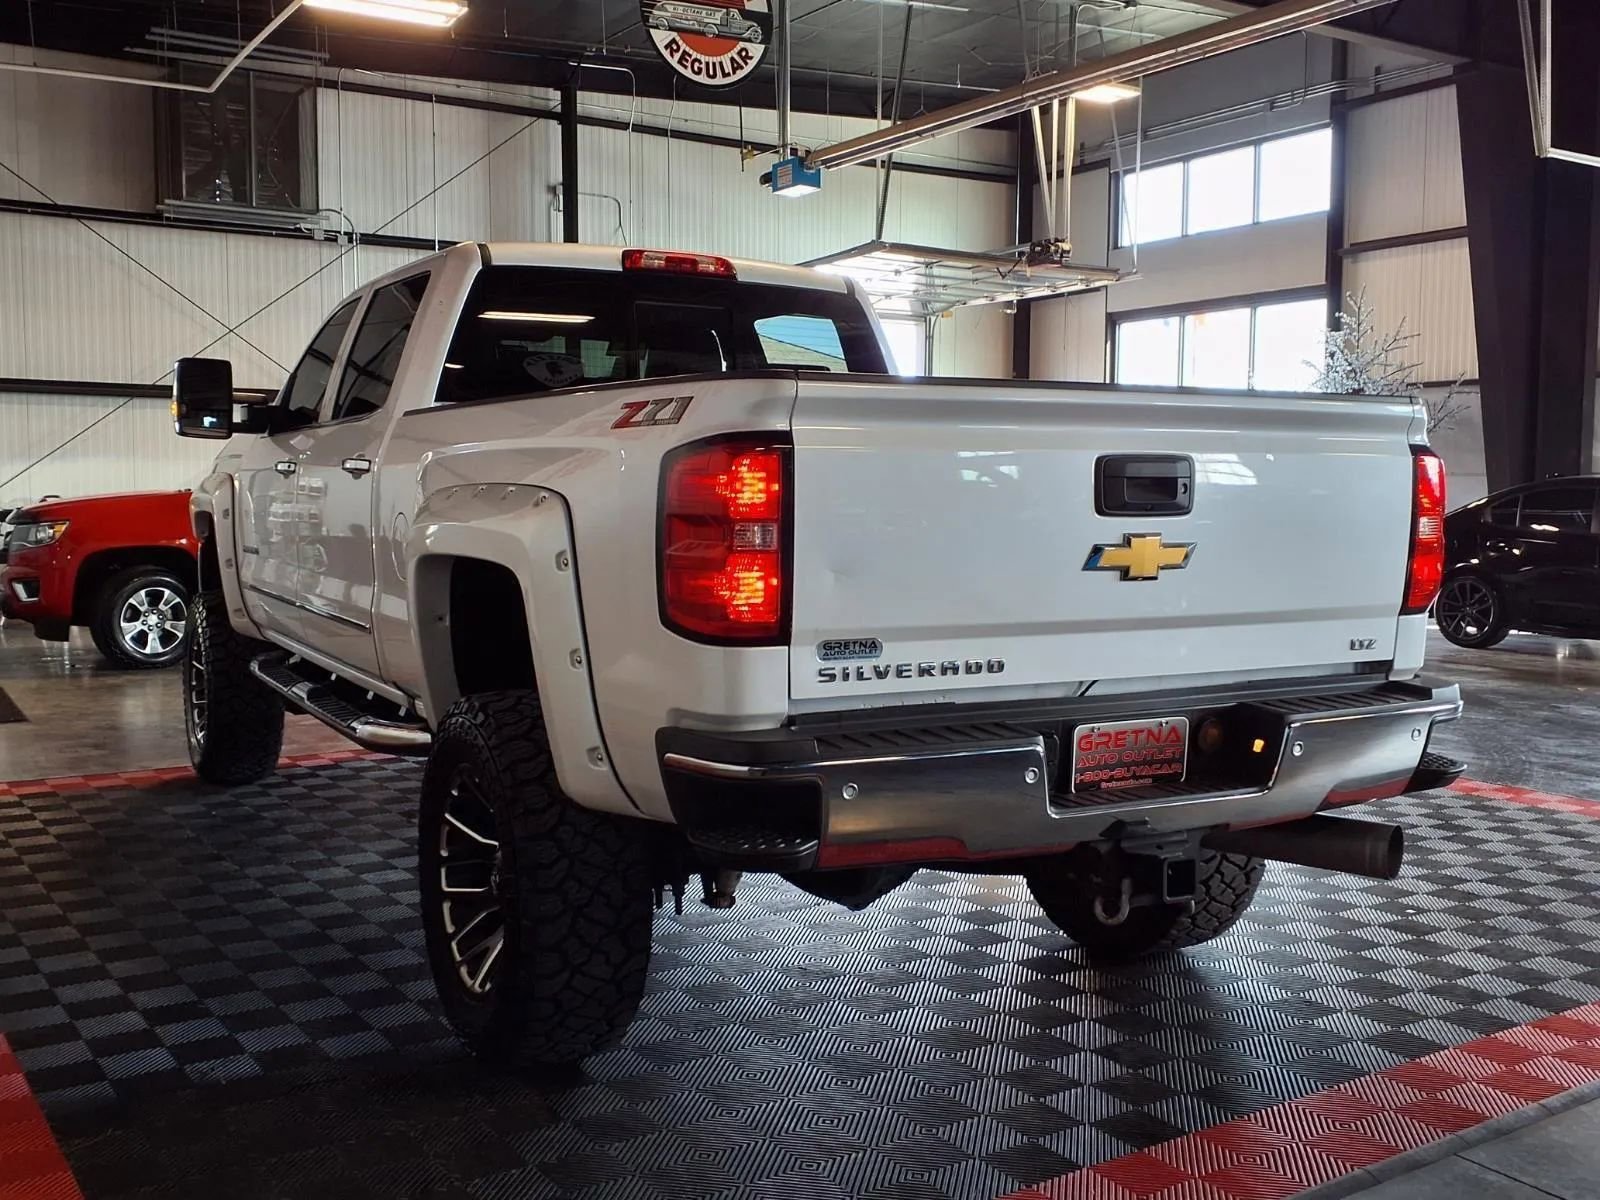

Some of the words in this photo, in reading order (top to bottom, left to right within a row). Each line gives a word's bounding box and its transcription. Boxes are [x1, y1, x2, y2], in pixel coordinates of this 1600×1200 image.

[663, 38, 754, 80] REGULAR
[610, 396, 694, 430] Z71
[822, 640, 878, 651] GRETNA
[847, 648, 878, 656] OUTLET
[1350, 639, 1376, 650] LTZ
[817, 657, 1006, 683] SILVERADO
[1077, 724, 1184, 752] GRETNA
[1077, 752, 1118, 768] AUTO
[1121, 747, 1183, 761] OUTLET
[1075, 763, 1183, 784] 1-800-BUYACAR
